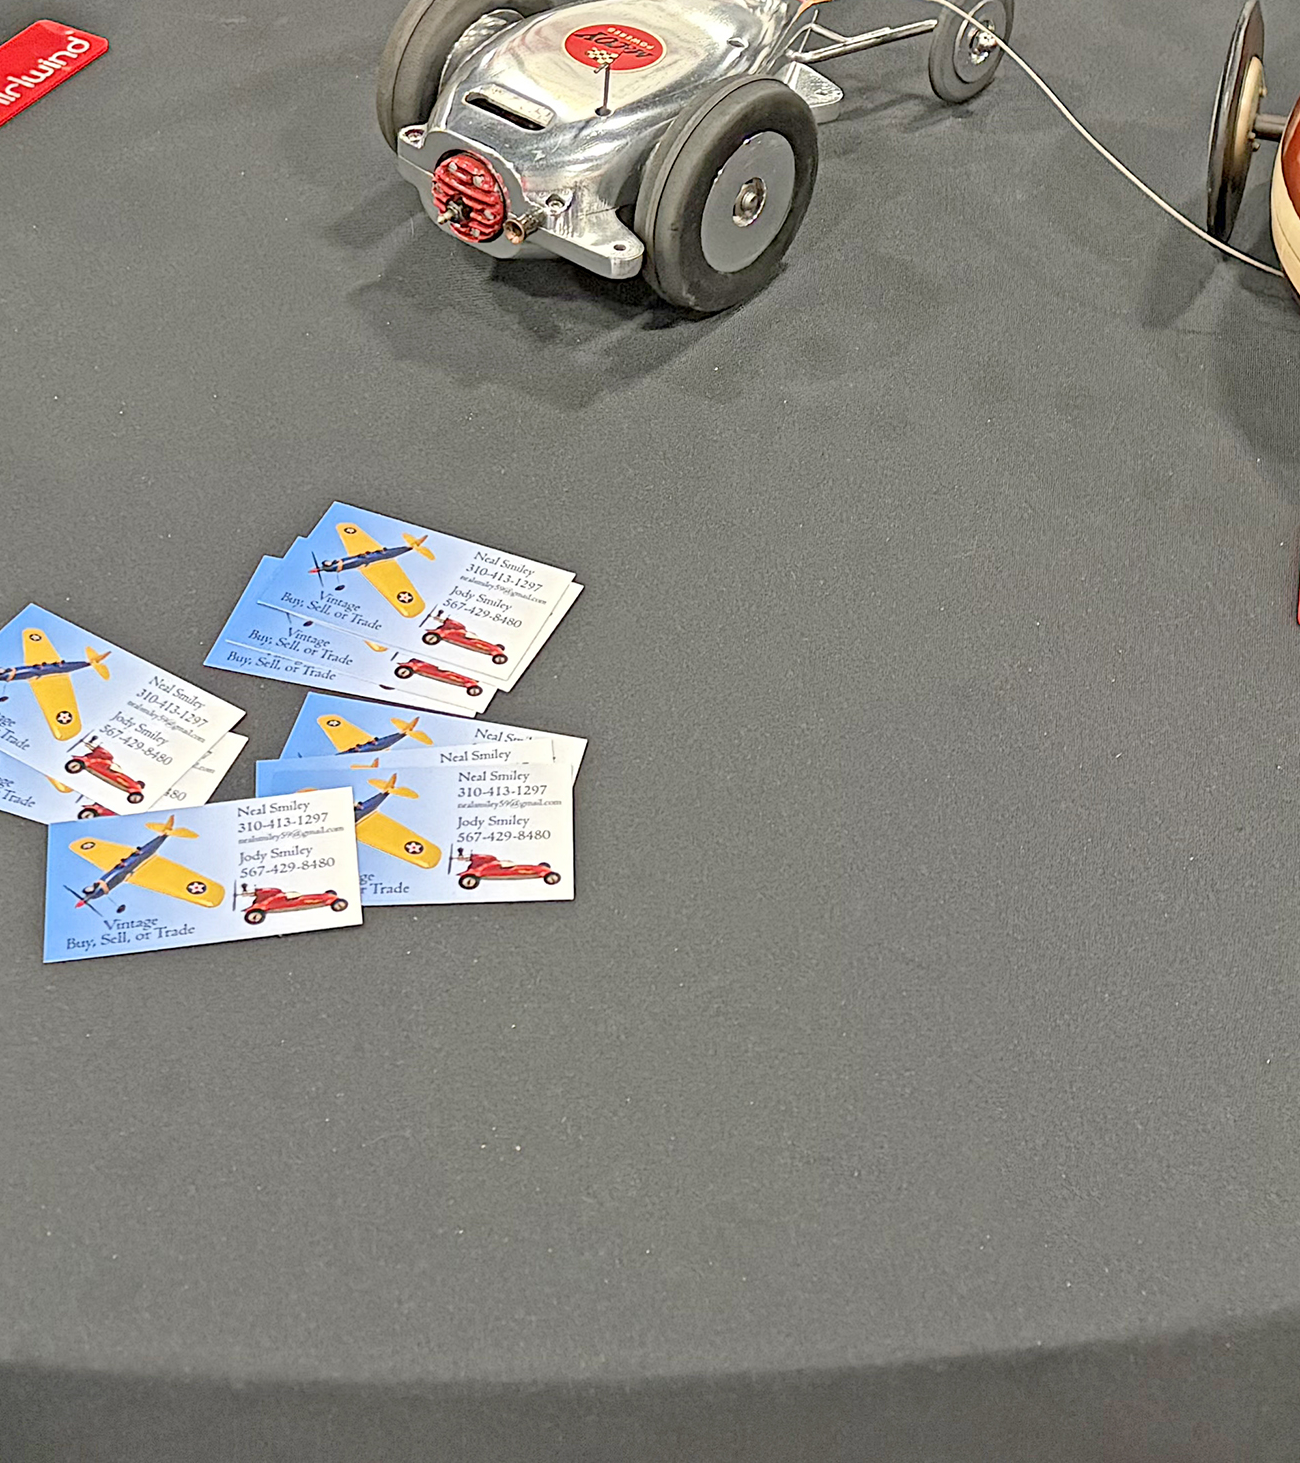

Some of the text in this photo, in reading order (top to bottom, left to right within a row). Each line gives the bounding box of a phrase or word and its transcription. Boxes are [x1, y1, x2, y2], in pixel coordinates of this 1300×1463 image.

[474, 551, 535, 578] Neal Smiley
[466, 563, 543, 592] 310-413-1297
[319, 590, 361, 612] Vintage
[449, 585, 512, 613] Jody Smiley
[334, 610, 350, 620] or
[350, 613, 382, 631] Trade
[443, 598, 522, 628] 567-429-8480
[288, 627, 330, 648] Vintage
[303, 646, 319, 657] or
[320, 648, 353, 666] Trade
[285, 663, 301, 673] or
[302, 665, 337, 681] Trade
[148, 676, 206, 711] Neal Smiley
[136, 688, 209, 728] 310-413-1297
[0, 727, 31, 751] Trade
[109, 711, 170, 747] Jody Smiley
[475, 728, 503, 742] Neal
[99, 724, 173, 766] 567-429-8480
[440, 749, 511, 764] Neal Smiley
[458, 770, 530, 783] Neal Smiley
[2, 788, 36, 808] Trade
[457, 784, 547, 798] 310-413-1297
[237, 800, 310, 818] Neal Smiley
[237, 811, 329, 833] 310-413-1297
[456, 815, 530, 830] Jody Smiley
[457, 829, 551, 843] 567-429-8480
[238, 845, 313, 866] Jody Smiley
[239, 856, 336, 879] 567-429-8480
[370, 881, 410, 895] Trade
[103, 917, 158, 931] Vintage
[135, 931, 151, 941] or
[154, 923, 195, 939] Trade
